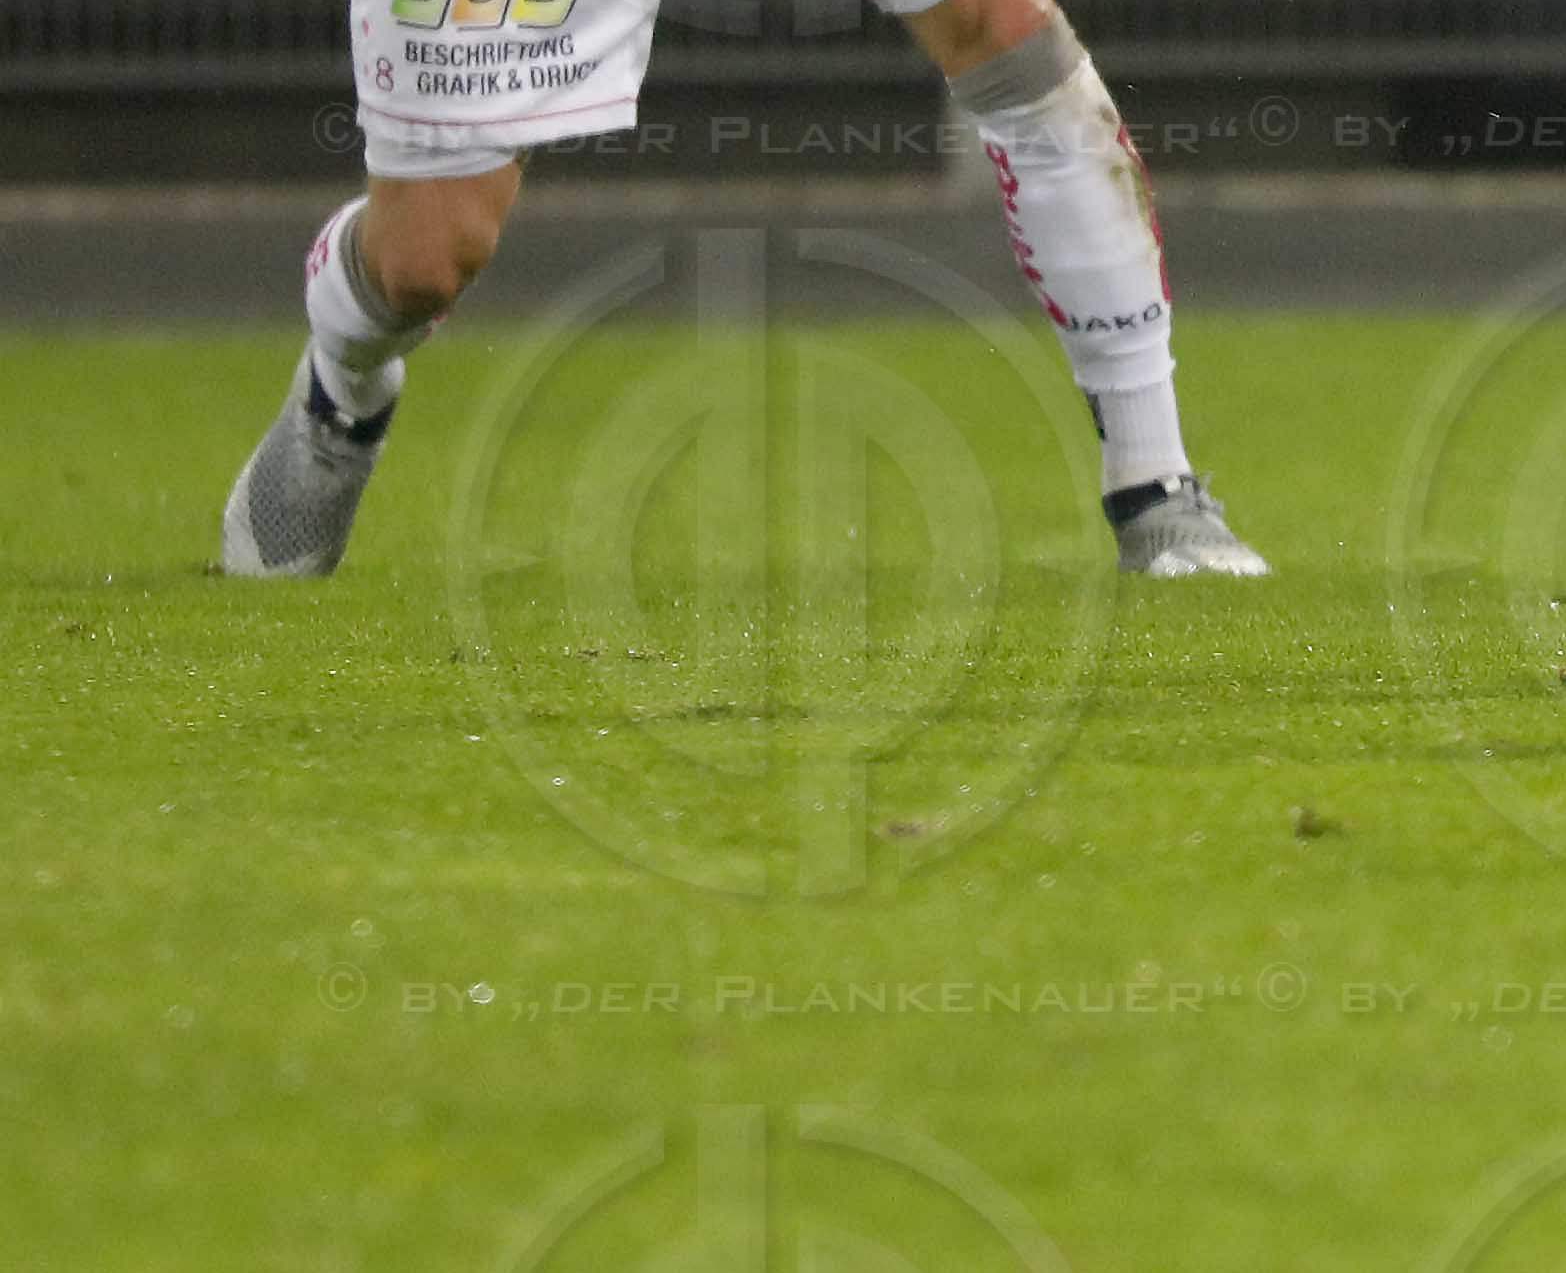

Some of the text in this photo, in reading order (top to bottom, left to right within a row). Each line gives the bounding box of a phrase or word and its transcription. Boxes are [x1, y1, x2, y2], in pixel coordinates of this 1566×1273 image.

[405, 35, 575, 67] BESCHRIFTUNG
[375, 57, 396, 91] 8
[416, 69, 500, 96] GRAFIK
[507, 68, 522, 91] &
